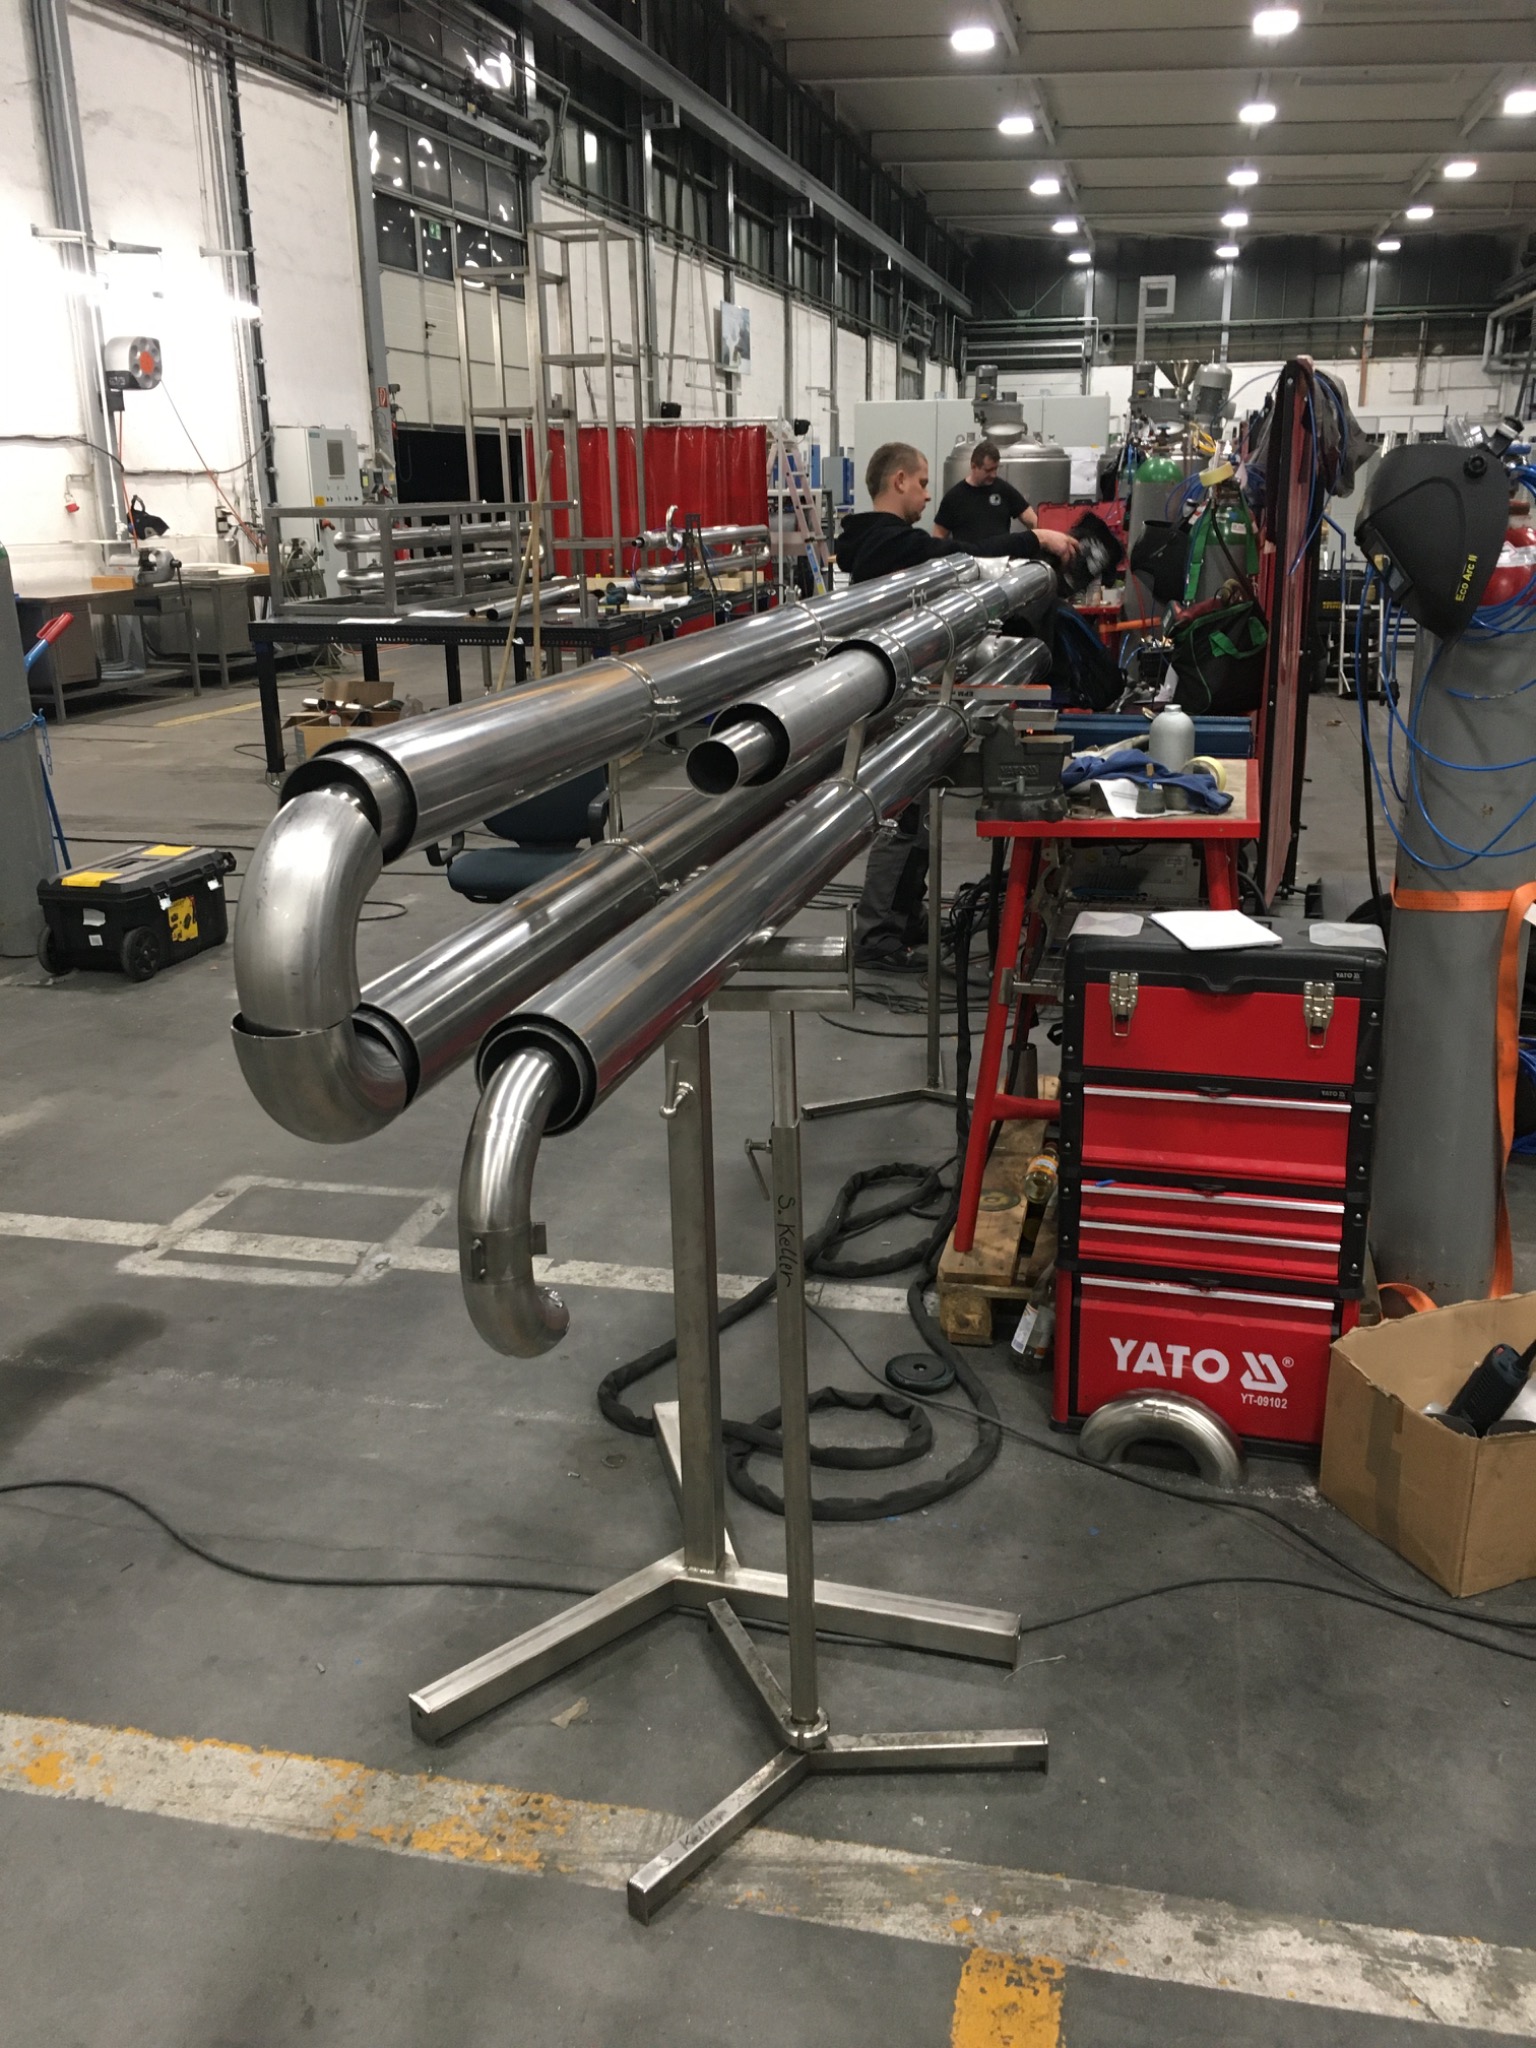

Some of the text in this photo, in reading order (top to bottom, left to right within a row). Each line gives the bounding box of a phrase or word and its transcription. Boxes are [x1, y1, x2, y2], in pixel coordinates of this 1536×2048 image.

[1455, 582, 1469, 602] Eco
[1462, 563, 1475, 582] Arc
[777, 1194, 798, 1288] S. Keller
[1109, 1337, 1230, 1384] YATO
[1240, 1393, 1288, 1410] YT-09102
